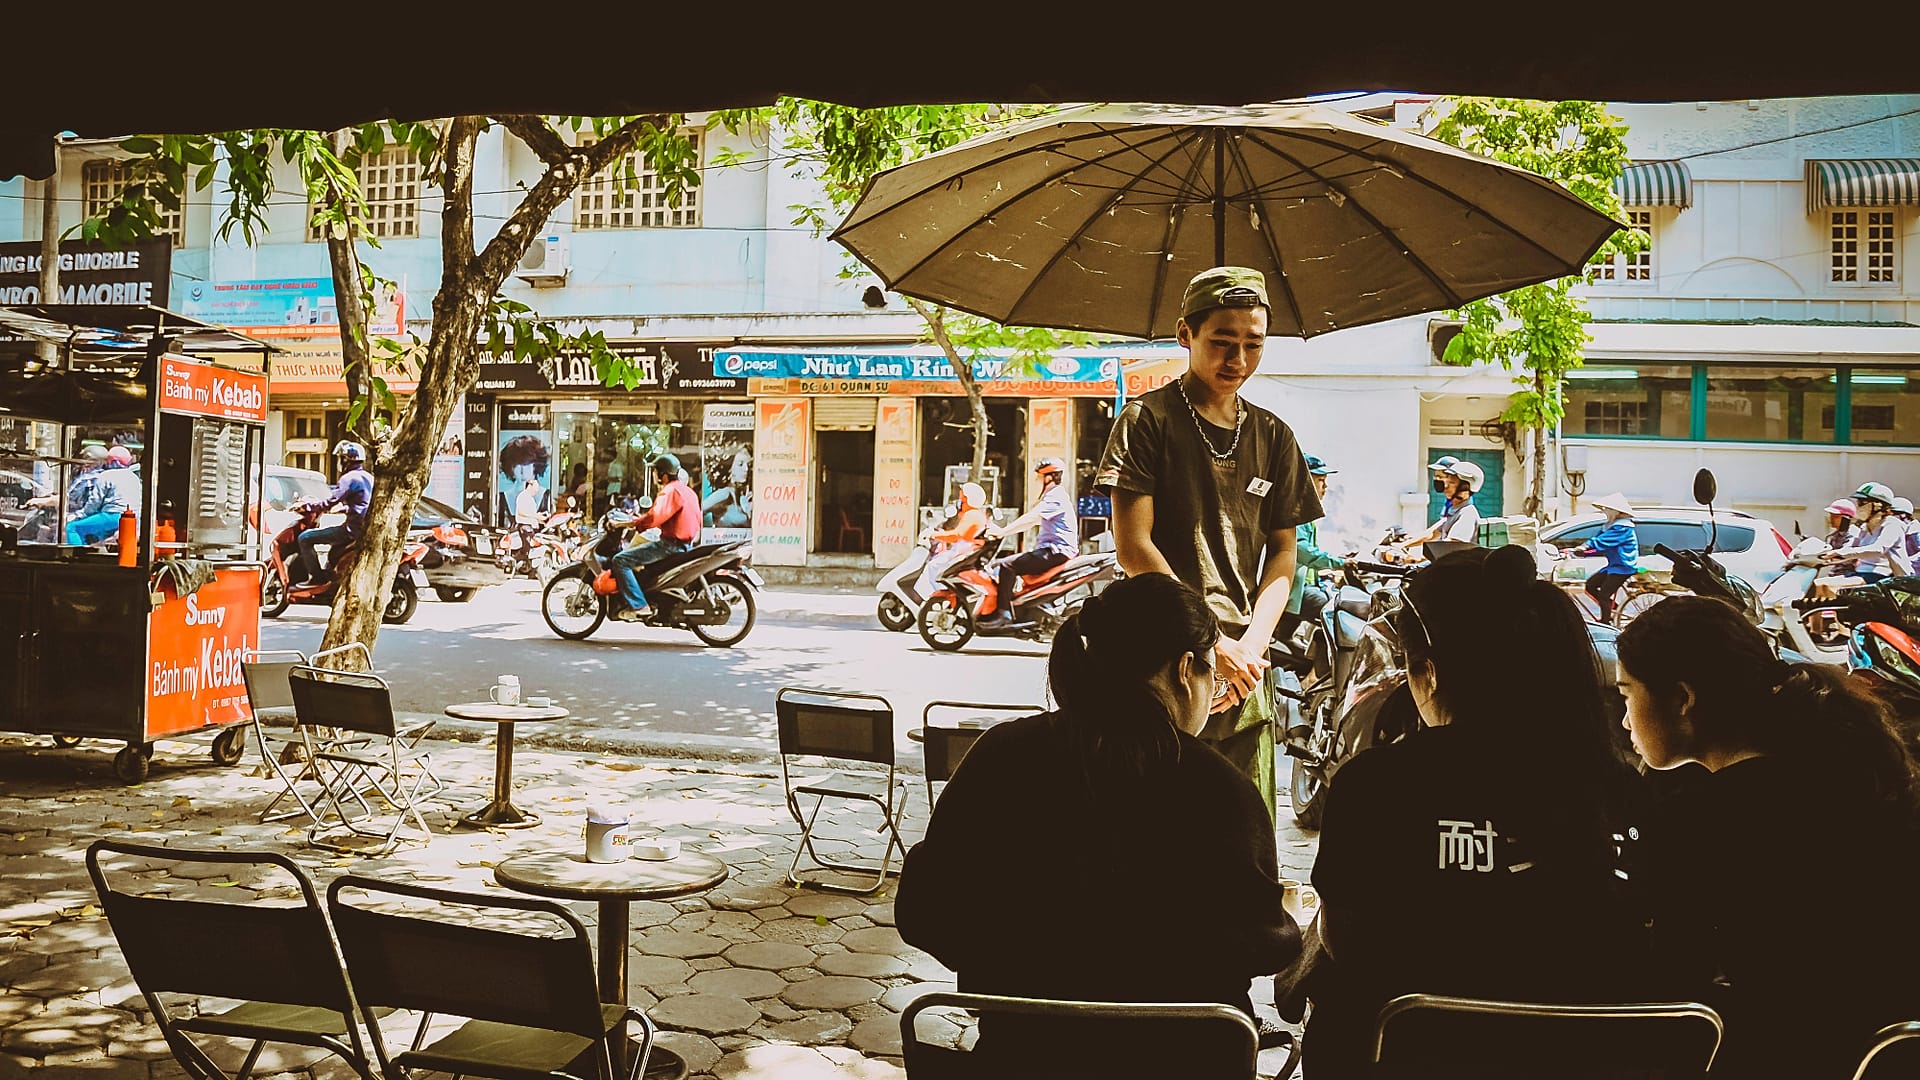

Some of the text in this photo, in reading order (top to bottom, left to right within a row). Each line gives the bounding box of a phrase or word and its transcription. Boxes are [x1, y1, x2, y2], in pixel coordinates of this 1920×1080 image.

[75, 251, 139, 271] MOBILE
[77, 282, 152, 304] MOBILE
[744, 358, 778, 372] pepsi
[801, 357, 852, 375] Như
[858, 358, 903, 376] Lan
[911, 359, 958, 377] Kin
[165, 379, 192, 400] Bánh
[212, 378, 262, 410] Kebab
[822, 382, 835, 391] 61
[468, 403, 486, 412] TIGI
[758, 511, 801, 528] NGON
[185, 593, 226, 628] Sunny
[153, 660, 181, 697] Bánh
